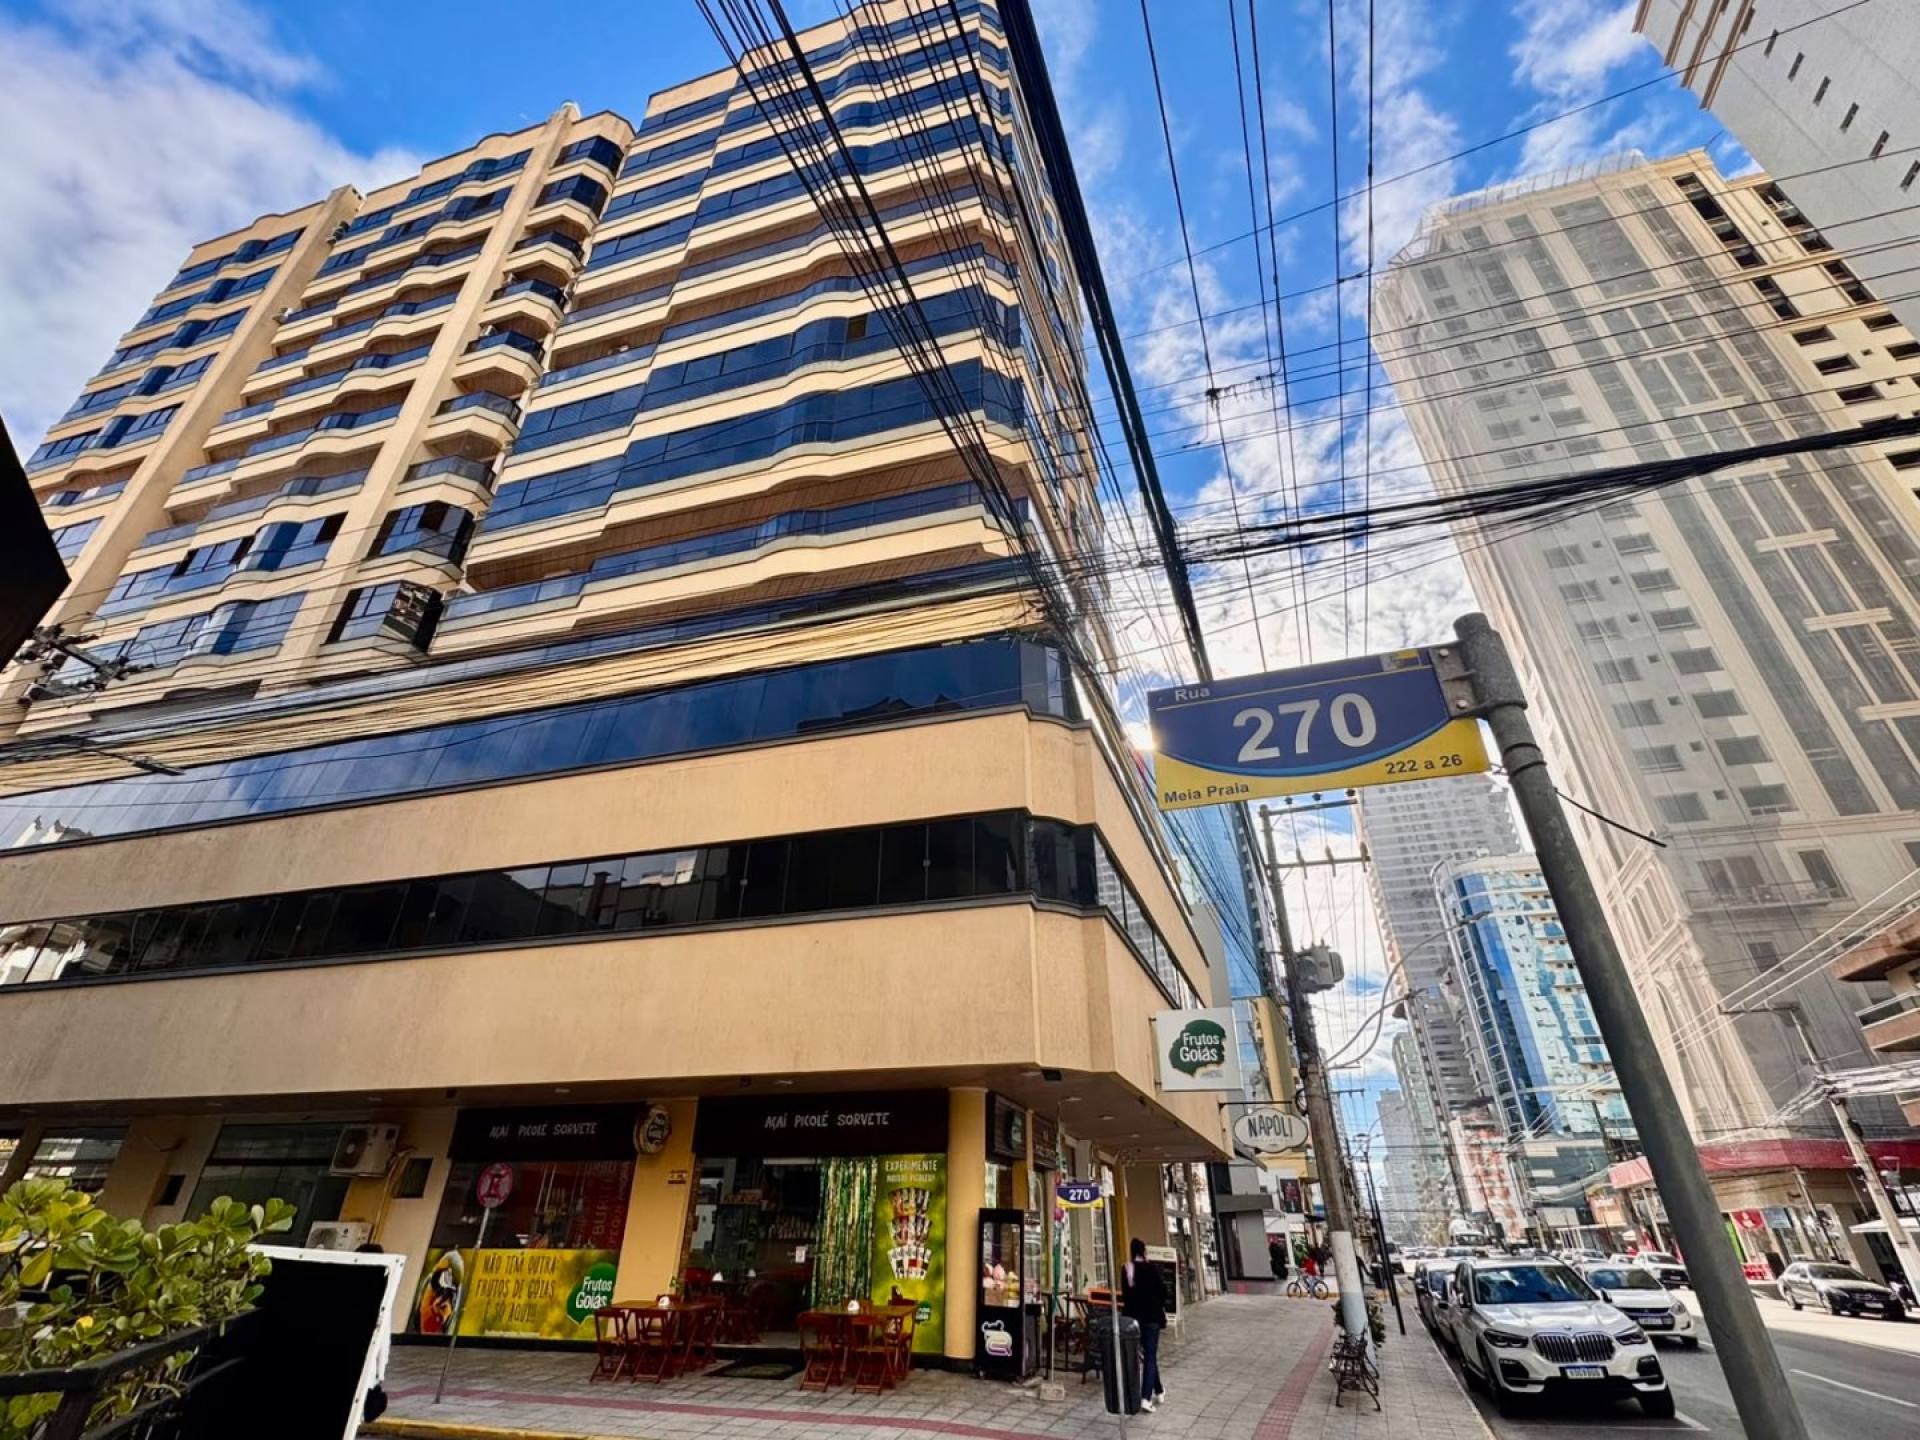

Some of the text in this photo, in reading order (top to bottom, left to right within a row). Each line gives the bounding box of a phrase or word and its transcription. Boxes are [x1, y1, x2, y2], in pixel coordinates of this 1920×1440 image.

[1175, 687, 1210, 702] Rua
[1232, 692, 1377, 763] 270
[1384, 754, 1463, 775] 222 a 26
[1164, 782, 1249, 804] Meia Praia
[1182, 1032, 1220, 1046] Frutos
[1180, 1046, 1218, 1062] Goiás
[794, 1110, 829, 1128] PICOLÉ
[837, 1112, 890, 1127] SORVETE
[1247, 1114, 1293, 1138] NAPOLI
[552, 1121, 598, 1136] SORVETE
[885, 1160, 938, 1172] EXPERIMENTE
[1069, 1188, 1090, 1201] 270
[476, 1278, 509, 1297] FRUTOS
[512, 1279, 525, 1298] DE
[582, 1276, 613, 1292] Frutos
